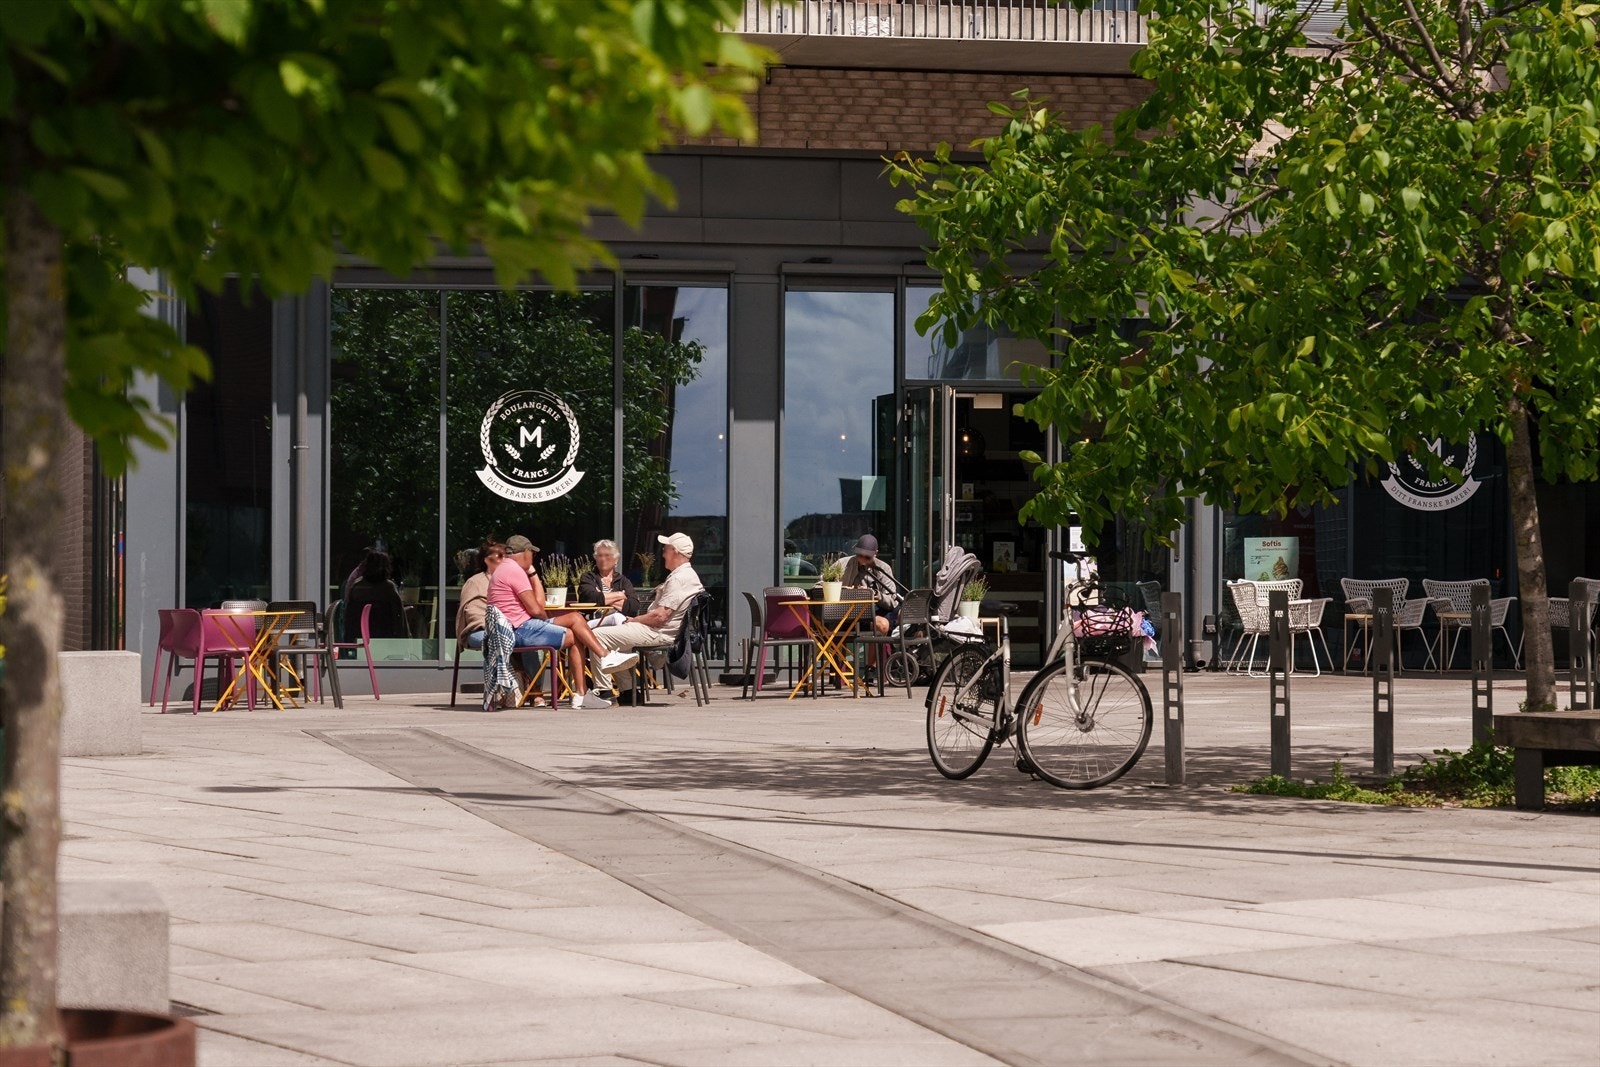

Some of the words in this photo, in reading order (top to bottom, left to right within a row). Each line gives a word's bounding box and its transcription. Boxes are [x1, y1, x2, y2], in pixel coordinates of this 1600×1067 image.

[499, 401, 561, 421] BOULANGERIE
[520, 425, 542, 448] M
[511, 467, 549, 478] FRANCE
[1414, 477, 1449, 488] FRANCE
[486, 476, 503, 491] DITT
[505, 488, 543, 499] FRANSKE
[545, 477, 573, 497] BAKERI
[1390, 485, 1406, 499] DITT
[1407, 497, 1443, 508] FRANSKE
[1445, 487, 1472, 505] BAKERI
